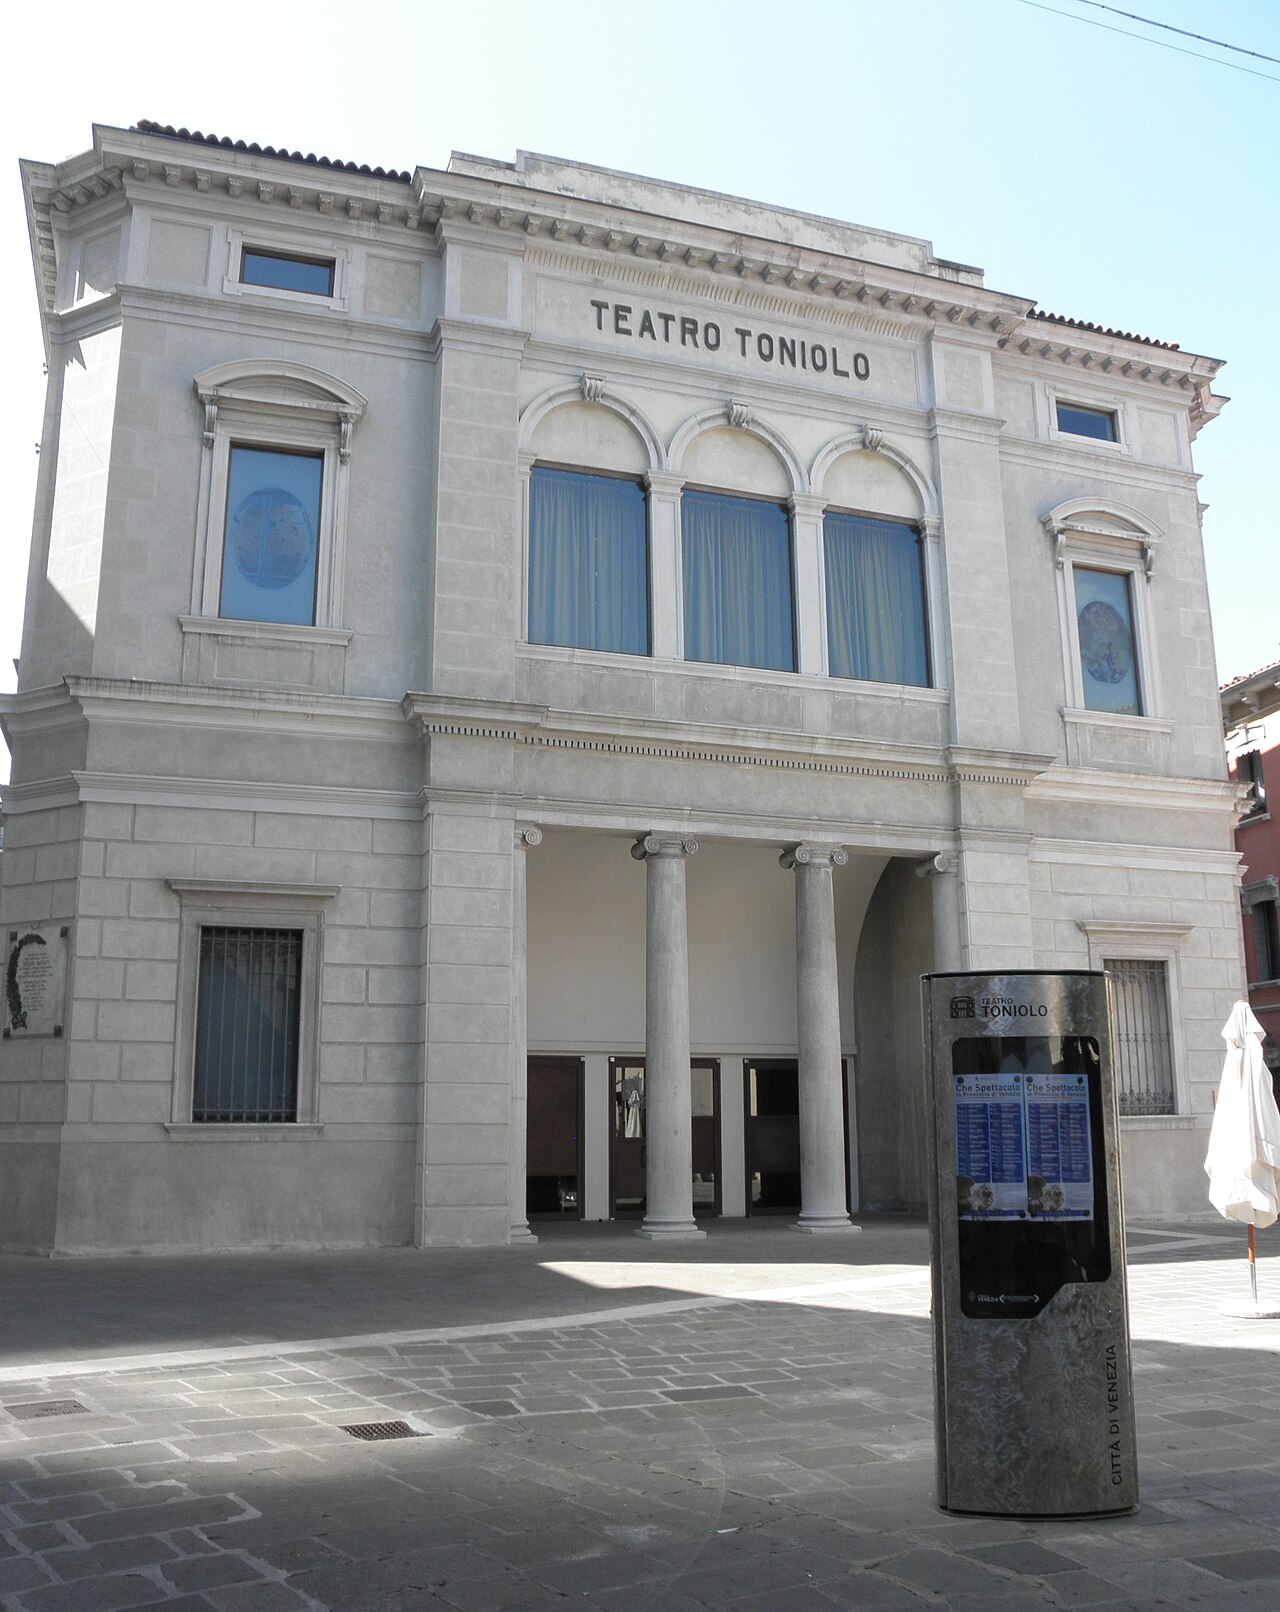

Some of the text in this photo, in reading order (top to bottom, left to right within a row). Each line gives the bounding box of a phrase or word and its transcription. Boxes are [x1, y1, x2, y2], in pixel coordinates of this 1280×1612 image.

[590, 299, 870, 381] TEATRO TONIOLO
[982, 1005, 1048, 1017] TONIOLO
[955, 1083, 1021, 1093] Che Spettacolo
[1026, 1083, 1086, 1093] Che Spettacolo
[1105, 1345, 1119, 1413] VENEZIA
[1109, 1419, 1120, 1435] DI
